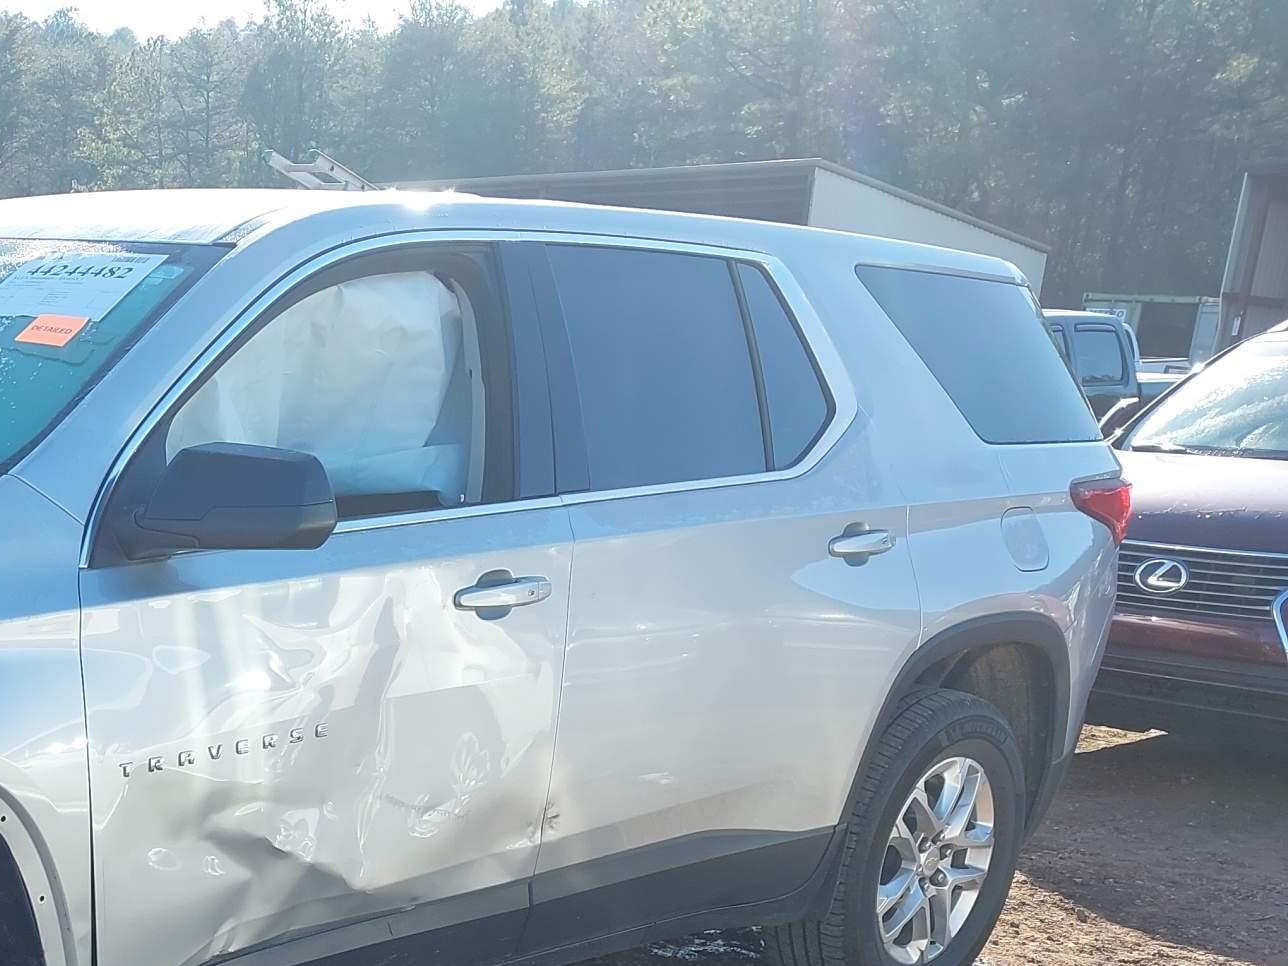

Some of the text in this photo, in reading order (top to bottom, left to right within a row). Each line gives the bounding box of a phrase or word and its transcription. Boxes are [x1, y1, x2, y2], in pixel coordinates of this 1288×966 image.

[26, 264, 134, 279] 44244482
[31, 325, 73, 334] DETAILED
[119, 723, 328, 777] TRAVERSE
